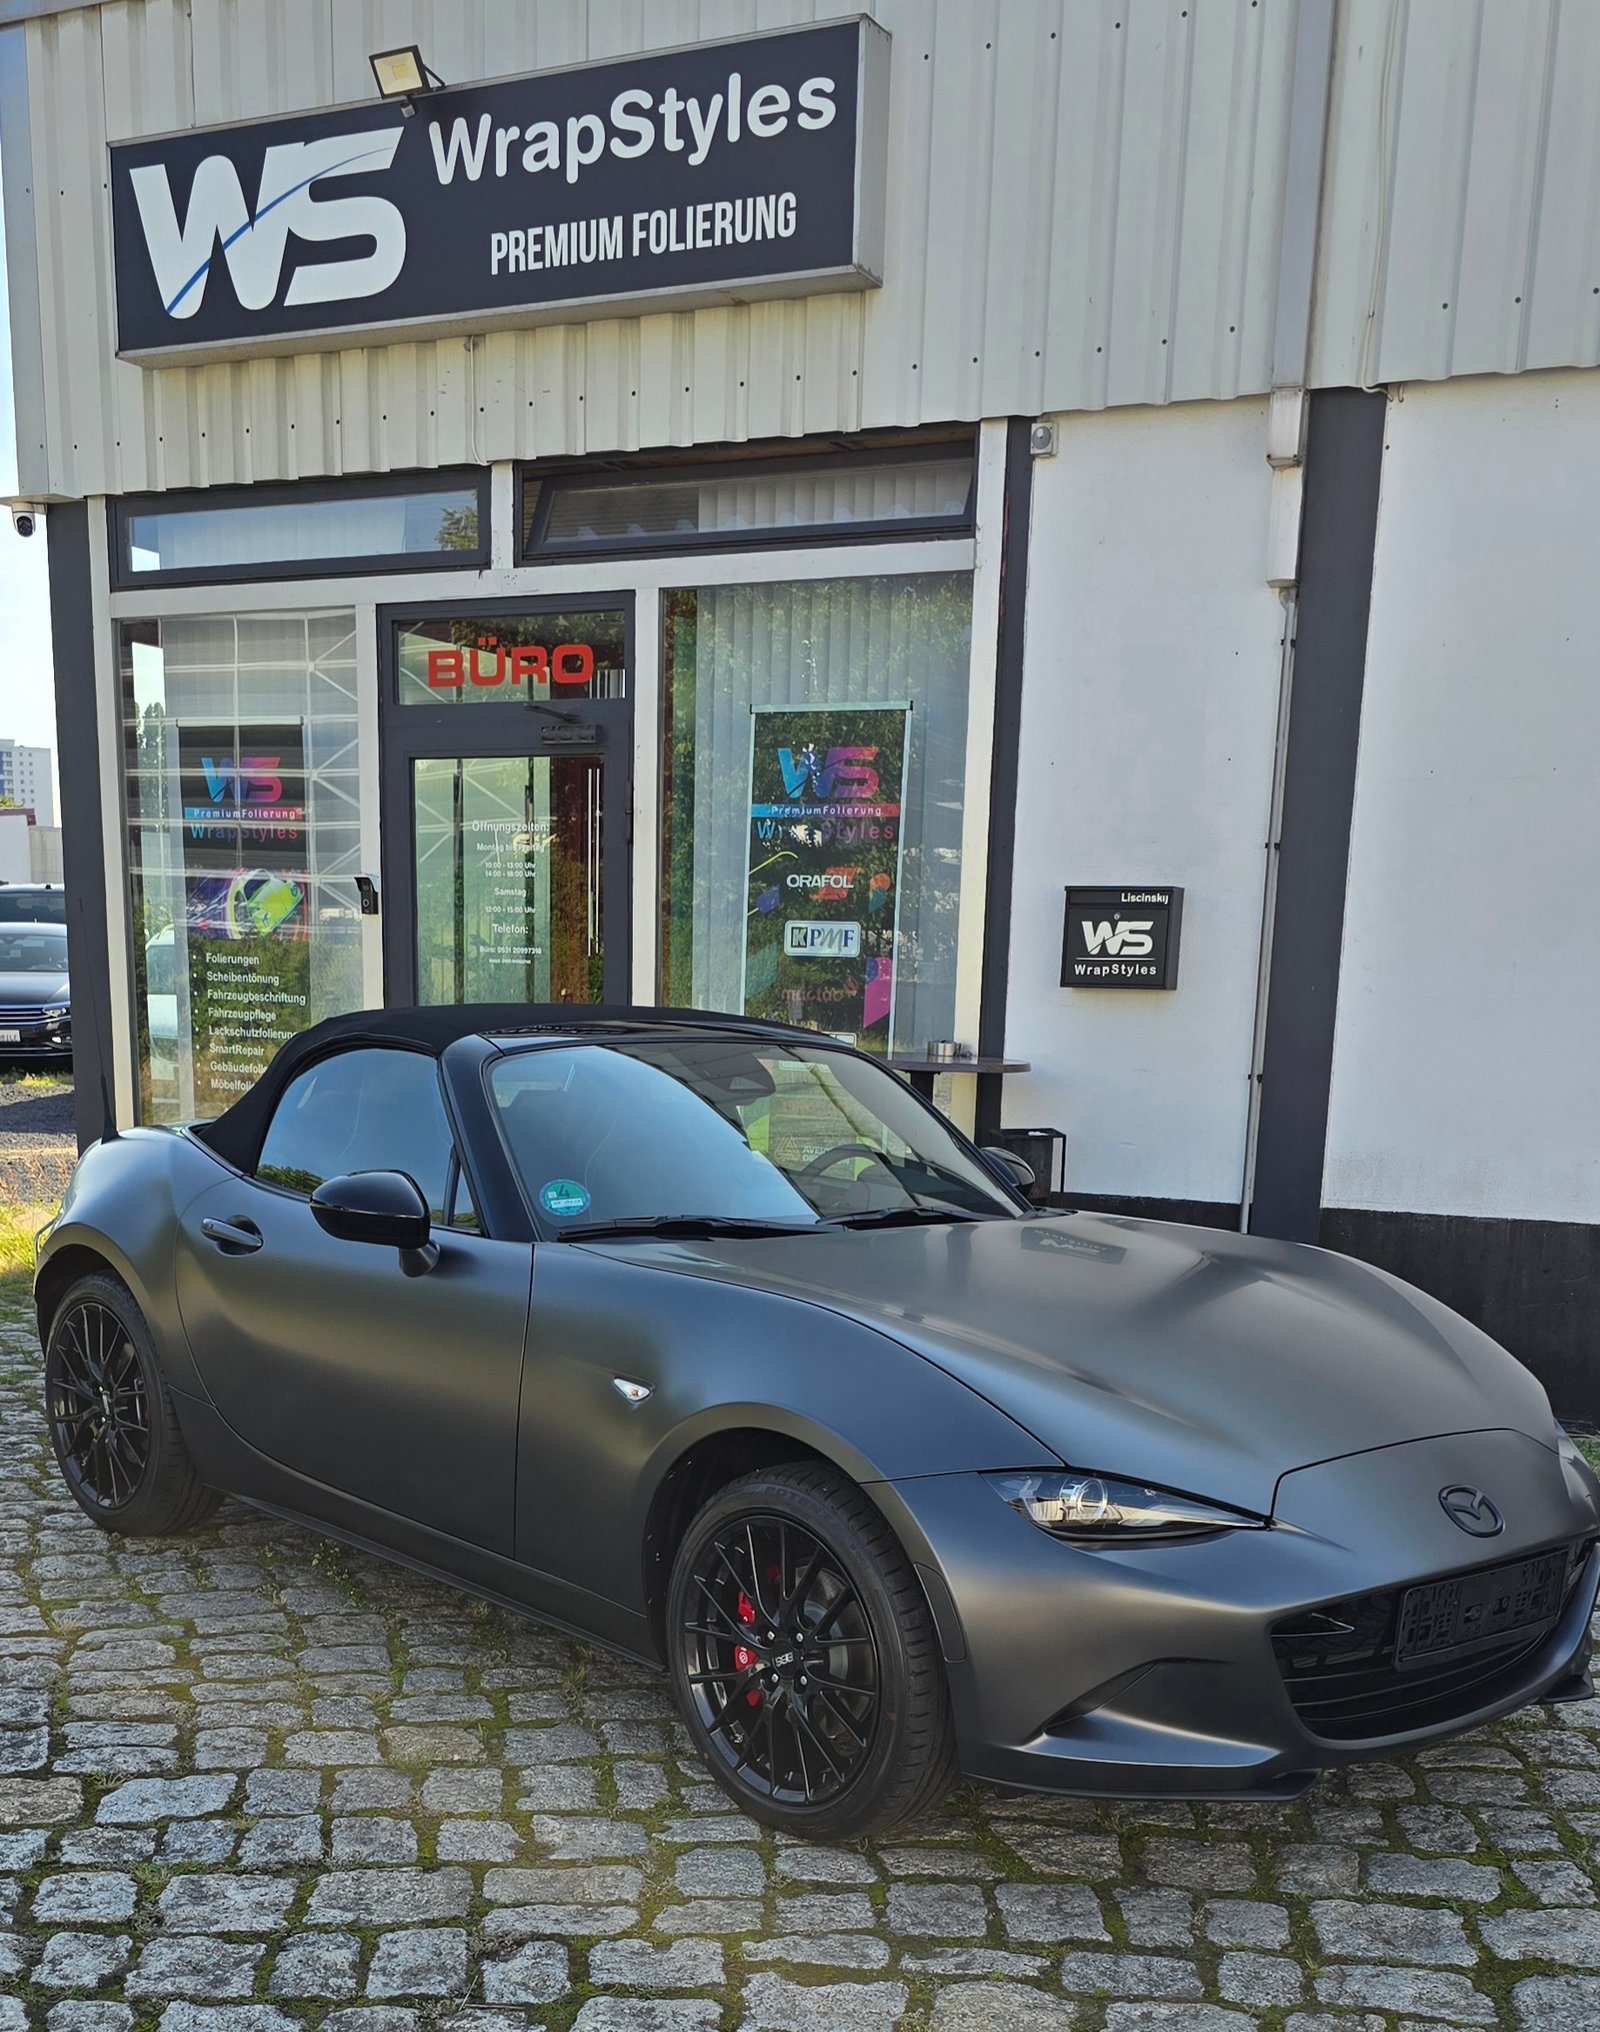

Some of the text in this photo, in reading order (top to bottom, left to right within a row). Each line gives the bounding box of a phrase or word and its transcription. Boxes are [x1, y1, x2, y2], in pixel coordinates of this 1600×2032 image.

[428, 72, 837, 185] WrapStyles
[129, 126, 407, 319] WS
[491, 192, 797, 275] PREMIUM FOLIERUNG
[427, 636, 594, 688] BÜRO
[194, 808, 296, 820] PremiumFolierung
[472, 820, 549, 833] Öffnungszeiten:
[757, 820, 894, 844] WrStyles
[787, 874, 854, 888] ORAFOL
[495, 887, 527, 897] Samstag
[492, 923, 529, 934] Telefon:
[791, 926, 854, 953] KPMF
[1081, 921, 1154, 955] WS
[206, 953, 260, 966] Folierungen
[1074, 964, 1157, 977] WrapStyles
[207, 971, 280, 986] Scheibentönung
[207, 989, 306, 1006] Fahrzeugbeschriftung
[208, 1007, 277, 1022] Fahrzeugpflege
[209, 1025, 297, 1039] Lackschutzfolierun
[209, 1043, 265, 1057] SmartRepair
